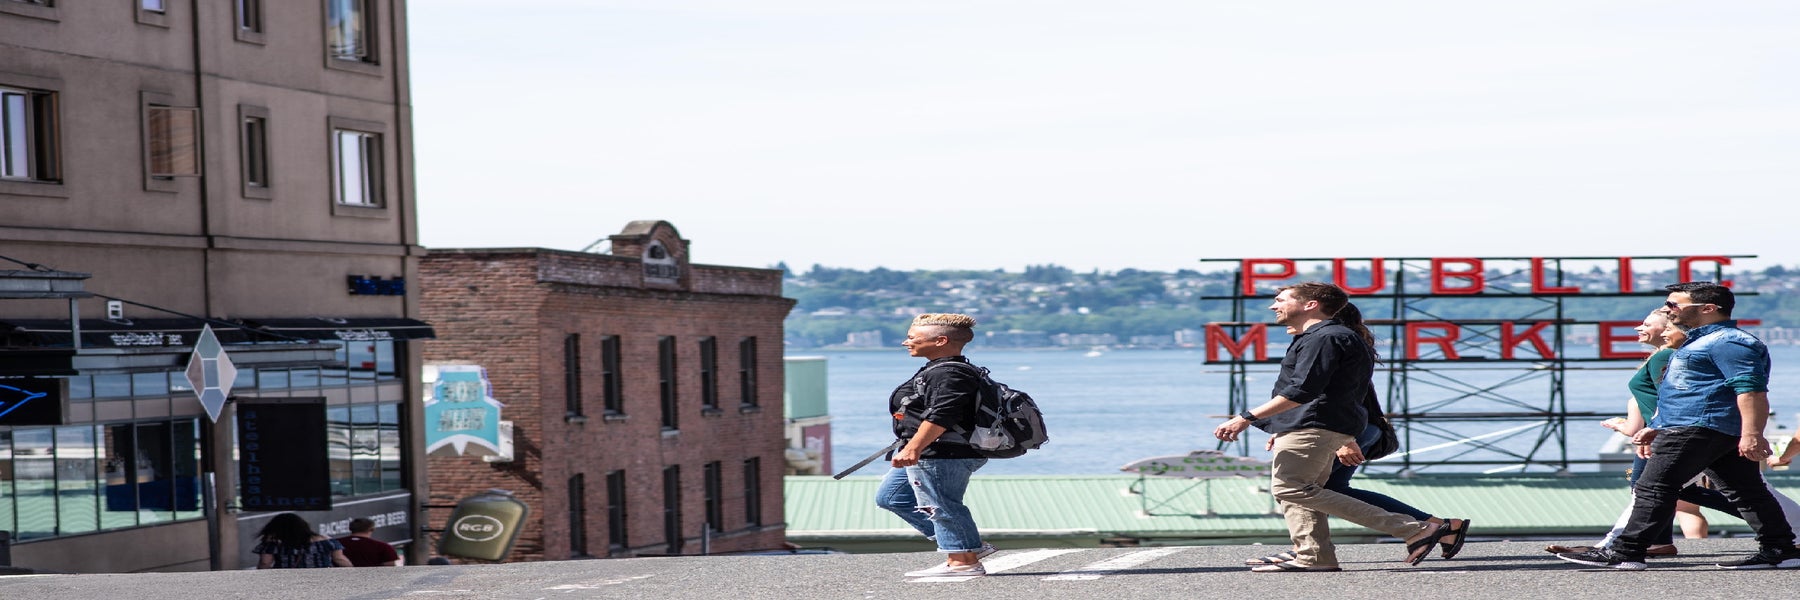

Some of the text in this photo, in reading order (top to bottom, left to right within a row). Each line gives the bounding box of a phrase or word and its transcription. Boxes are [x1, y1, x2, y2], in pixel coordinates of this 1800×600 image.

[1242, 256, 1735, 295] PUBLIC
[1205, 320, 1762, 361] MRKE
[387, 511, 407, 525] BEER
[460, 523, 494, 532] RGB
